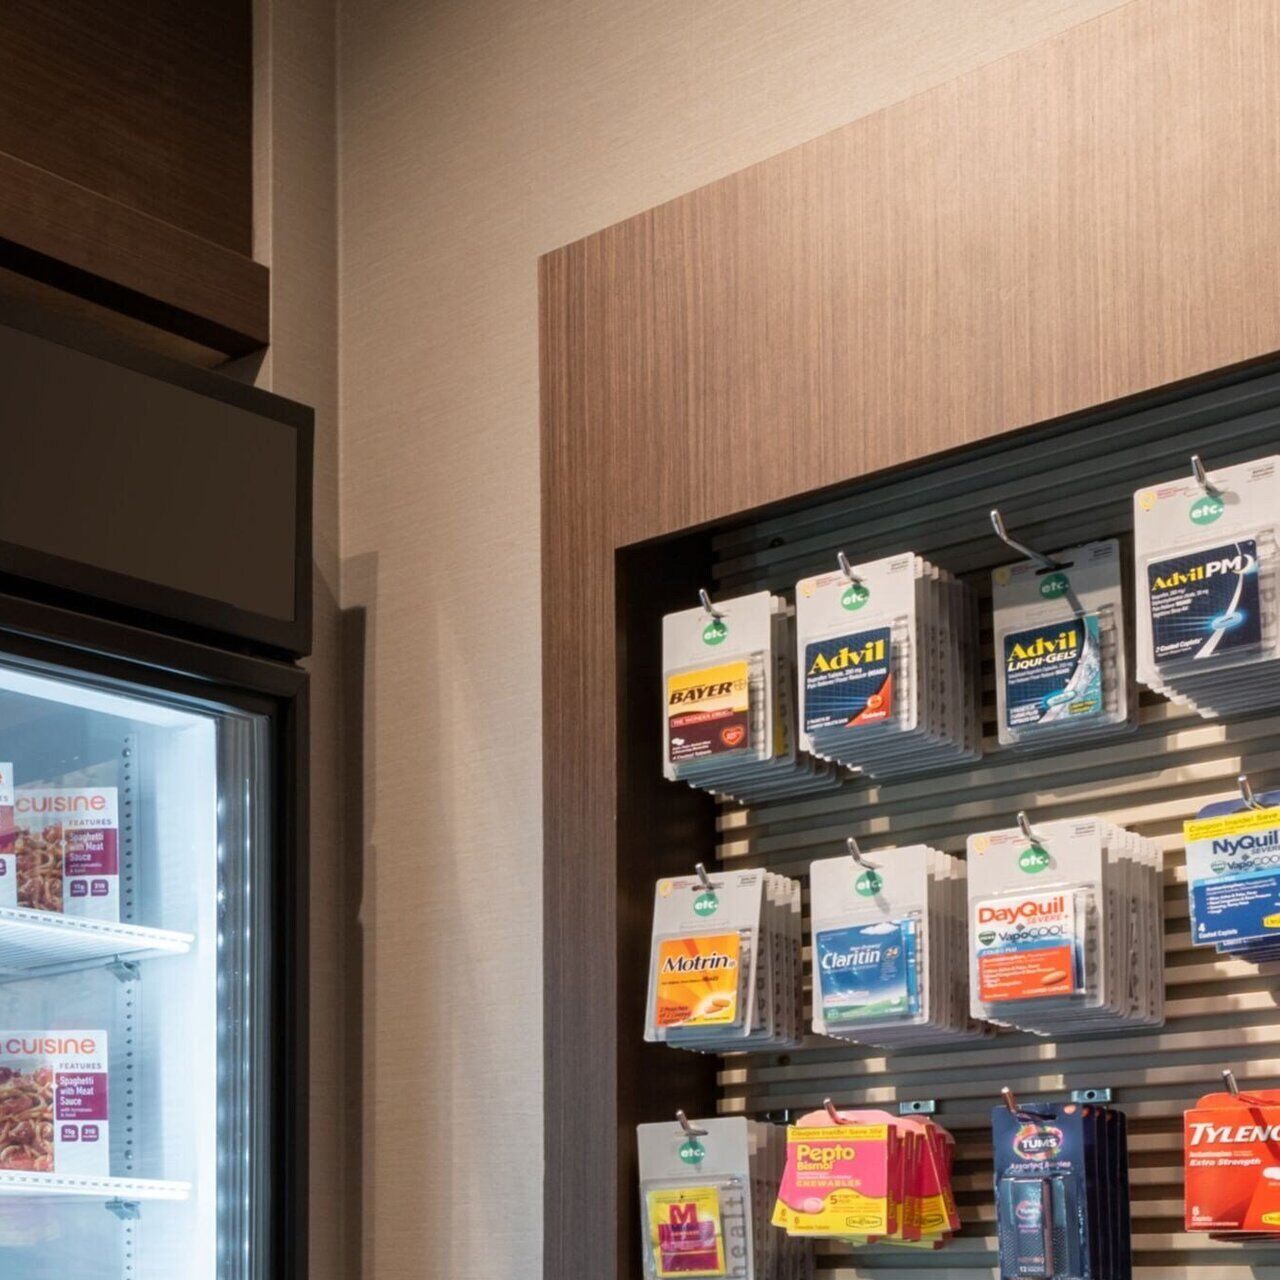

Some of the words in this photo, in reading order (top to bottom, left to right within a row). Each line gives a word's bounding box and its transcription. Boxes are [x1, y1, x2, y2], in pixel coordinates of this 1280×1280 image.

[1192, 505, 1225, 519] etc.
[1152, 566, 1206, 591] Advil
[1206, 555, 1242, 579] PM
[1042, 580, 1069, 593] etc.
[842, 593, 870, 606] etc.
[1007, 631, 1077, 661] Advil
[808, 640, 886, 674] Advil
[1007, 651, 1077, 671] LIQUI-GELS
[669, 682, 734, 706] BAYER
[16, 795, 106, 812] cuisine
[69, 818, 112, 827] FEATURES
[69, 832, 104, 845] Spaghetti
[1212, 834, 1280, 856] NyQuil
[69, 852, 92, 862] Sauce
[1020, 856, 1049, 867] etc.
[978, 897, 1065, 926] DayQuil
[998, 925, 1067, 943] VapoCOOL
[662, 953, 729, 975] Motrin
[822, 949, 881, 971] Claritin
[6, 1037, 95, 1055] cuisine
[59, 1062, 102, 1070] FEATURES
[60, 1075, 94, 1088] Spaghetti
[60, 1095, 82, 1106] Sauce
[1189, 1122, 1280, 1145] TYLENO
[1022, 1138, 1057, 1149] TUMS
[796, 1144, 856, 1165] Pepto
[796, 1161, 835, 1172] Bismol
[1217, 1158, 1261, 1167] Strength
[796, 1179, 862, 1188] CHEWABLES
